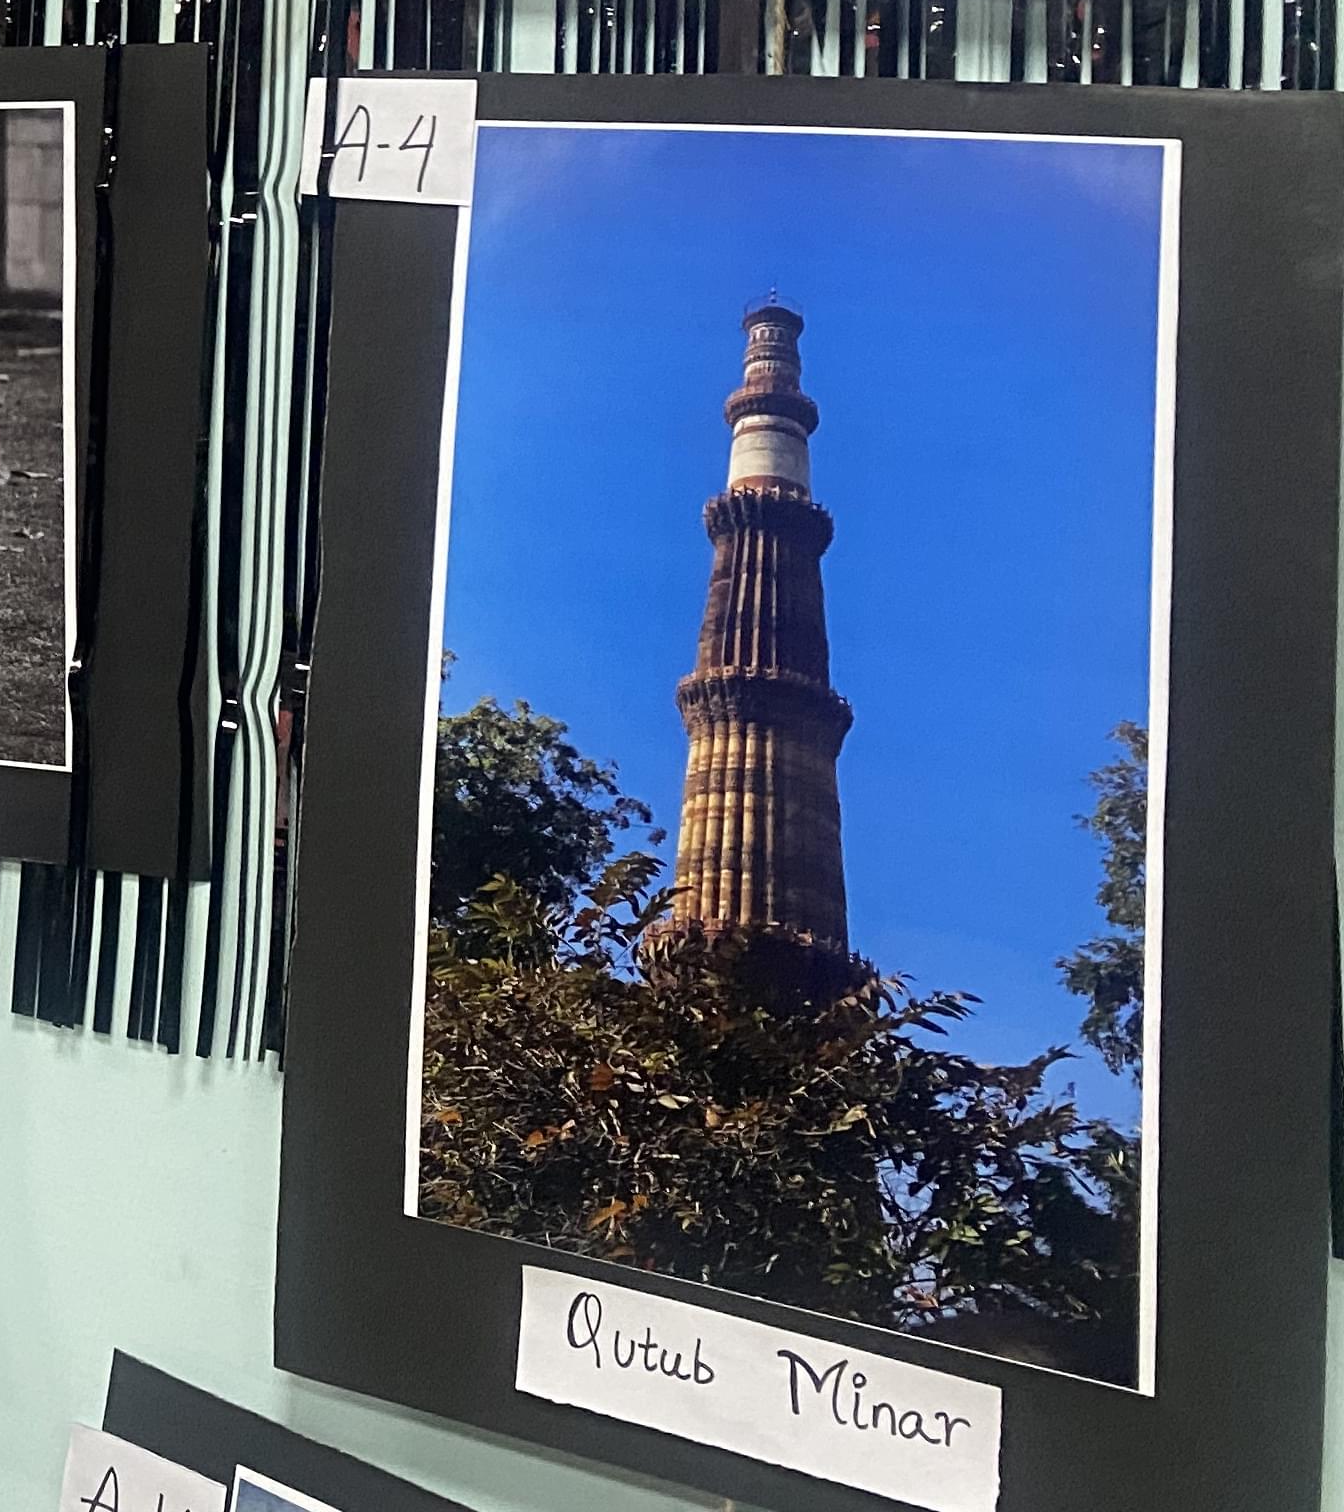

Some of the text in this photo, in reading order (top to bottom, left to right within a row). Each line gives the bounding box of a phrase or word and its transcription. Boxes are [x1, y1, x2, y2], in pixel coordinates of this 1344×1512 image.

[322, 104, 437, 193] A-4
[567, 1292, 971, 1447] Qutub Minar
